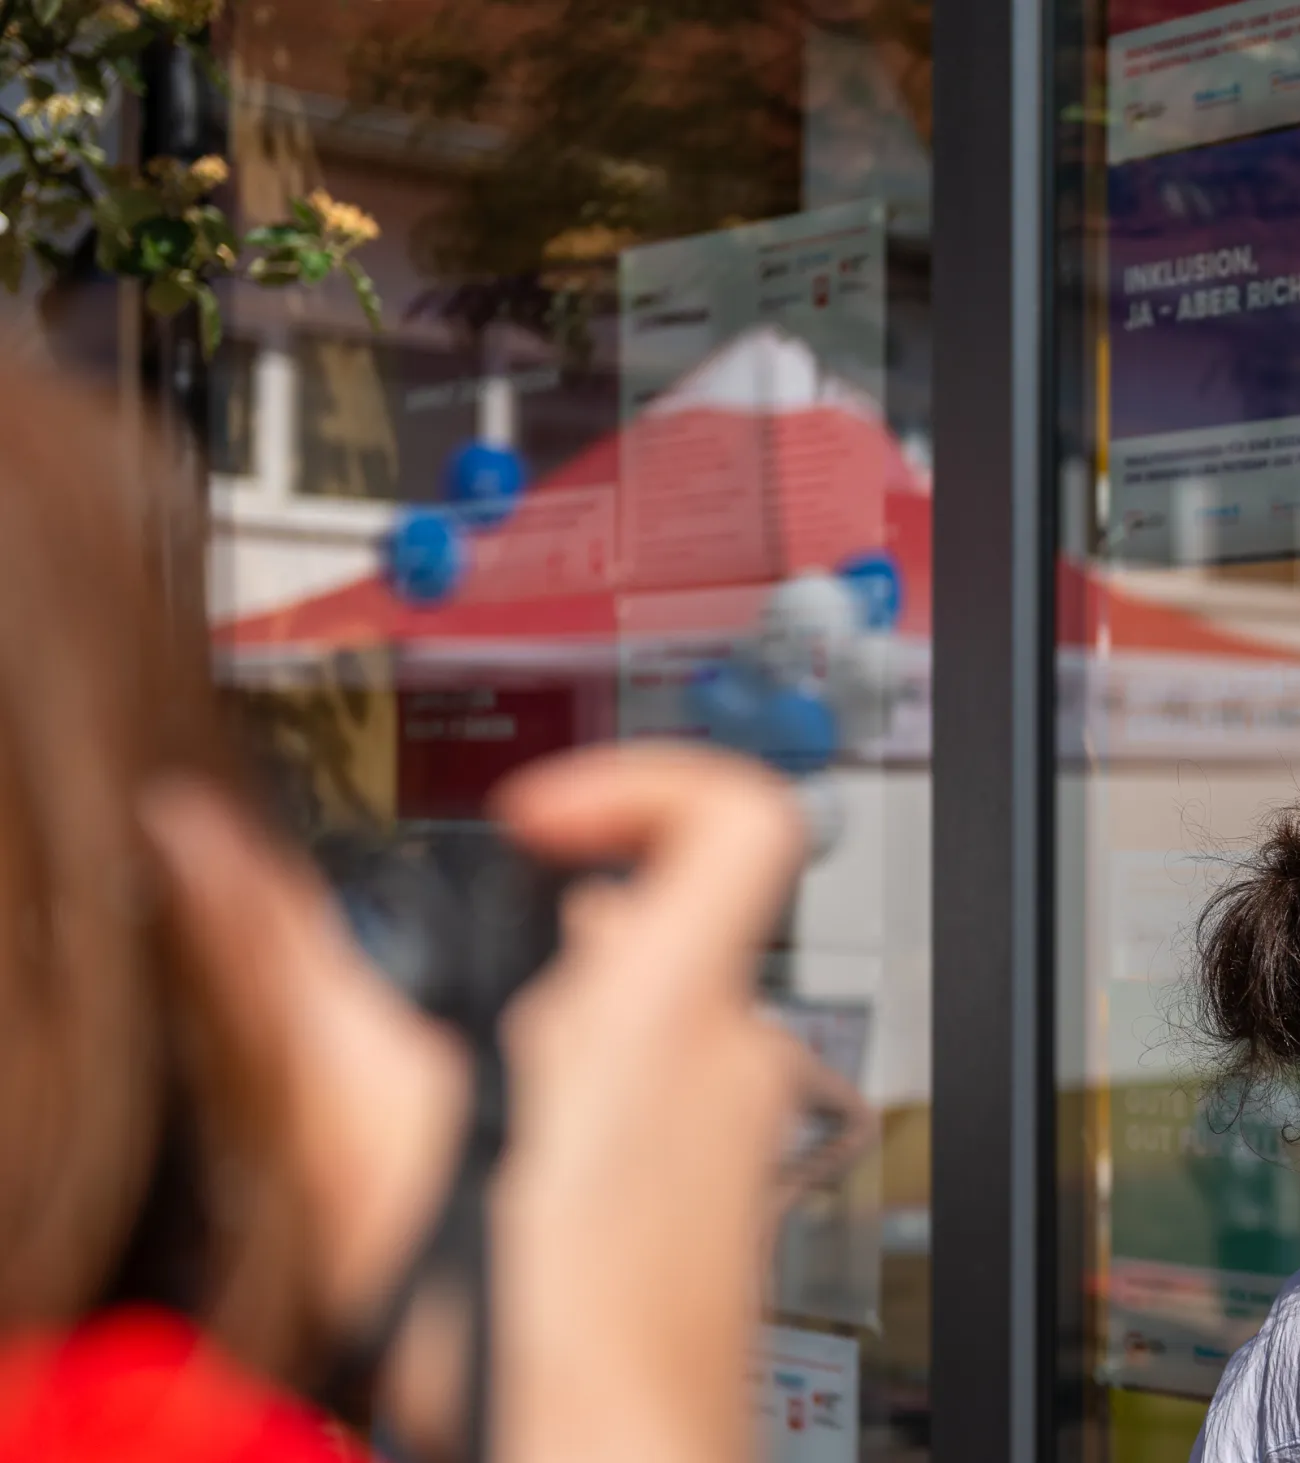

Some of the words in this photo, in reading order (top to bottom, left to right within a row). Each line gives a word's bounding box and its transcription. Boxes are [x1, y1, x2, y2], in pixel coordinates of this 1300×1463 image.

[1124, 244, 1259, 295] INKLUSION,
[1124, 299, 1156, 332] JA
[1176, 285, 1241, 322] ABER
